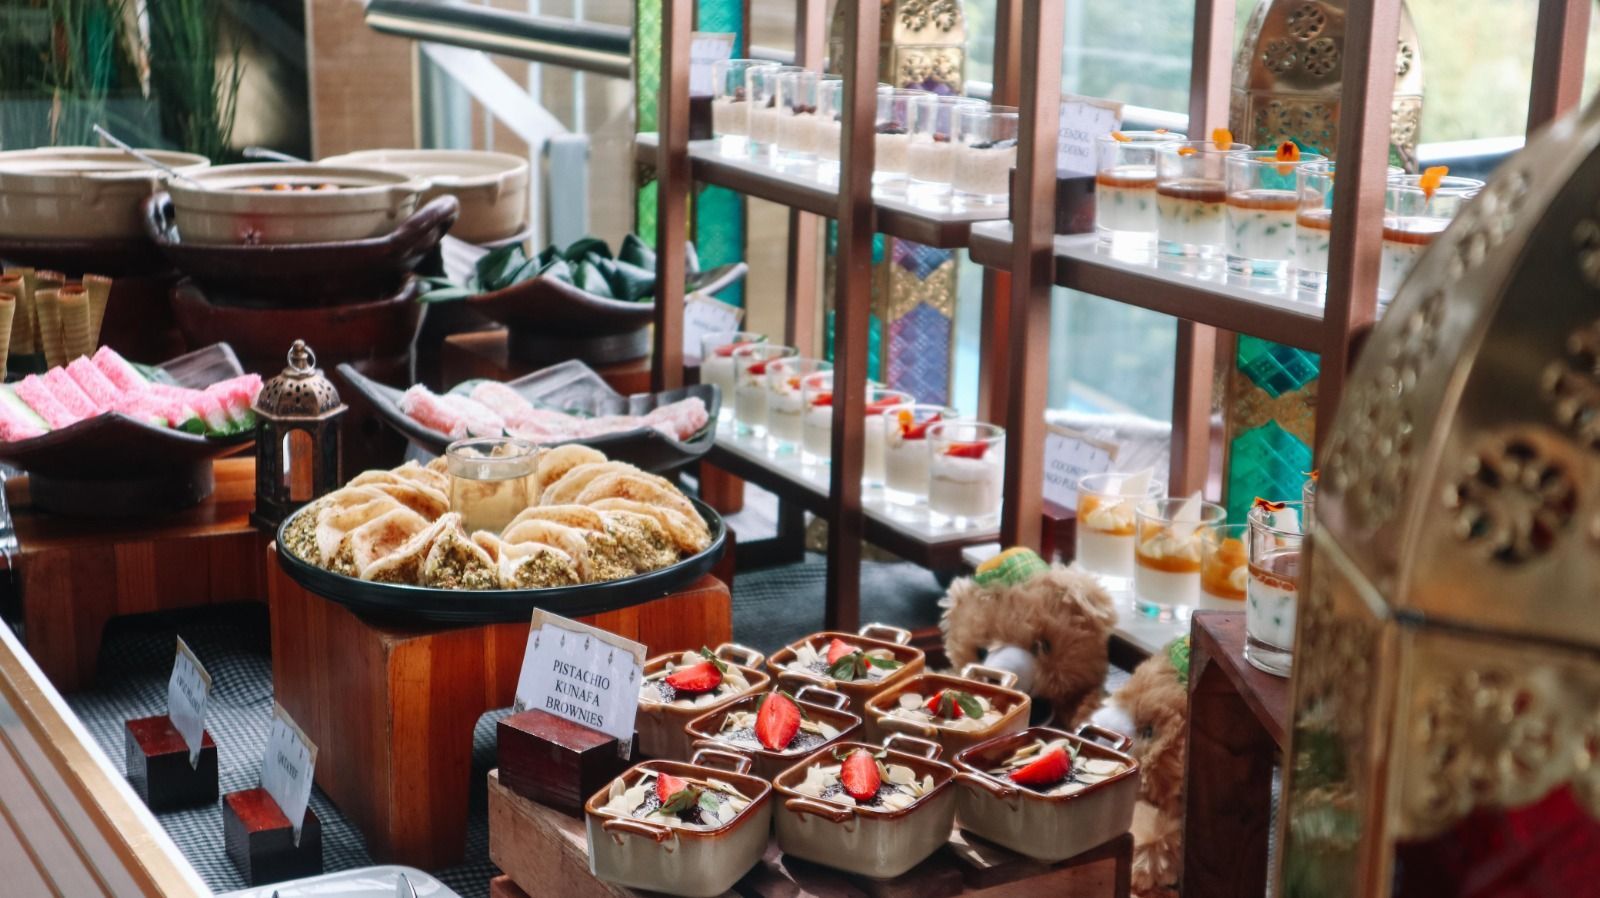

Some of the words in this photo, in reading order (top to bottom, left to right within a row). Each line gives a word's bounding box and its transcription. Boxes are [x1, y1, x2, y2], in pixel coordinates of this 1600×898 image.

[553, 659, 610, 690] PISTACHIO
[555, 680, 600, 707] KUNAFA
[545, 696, 604, 727] BROWNIES
